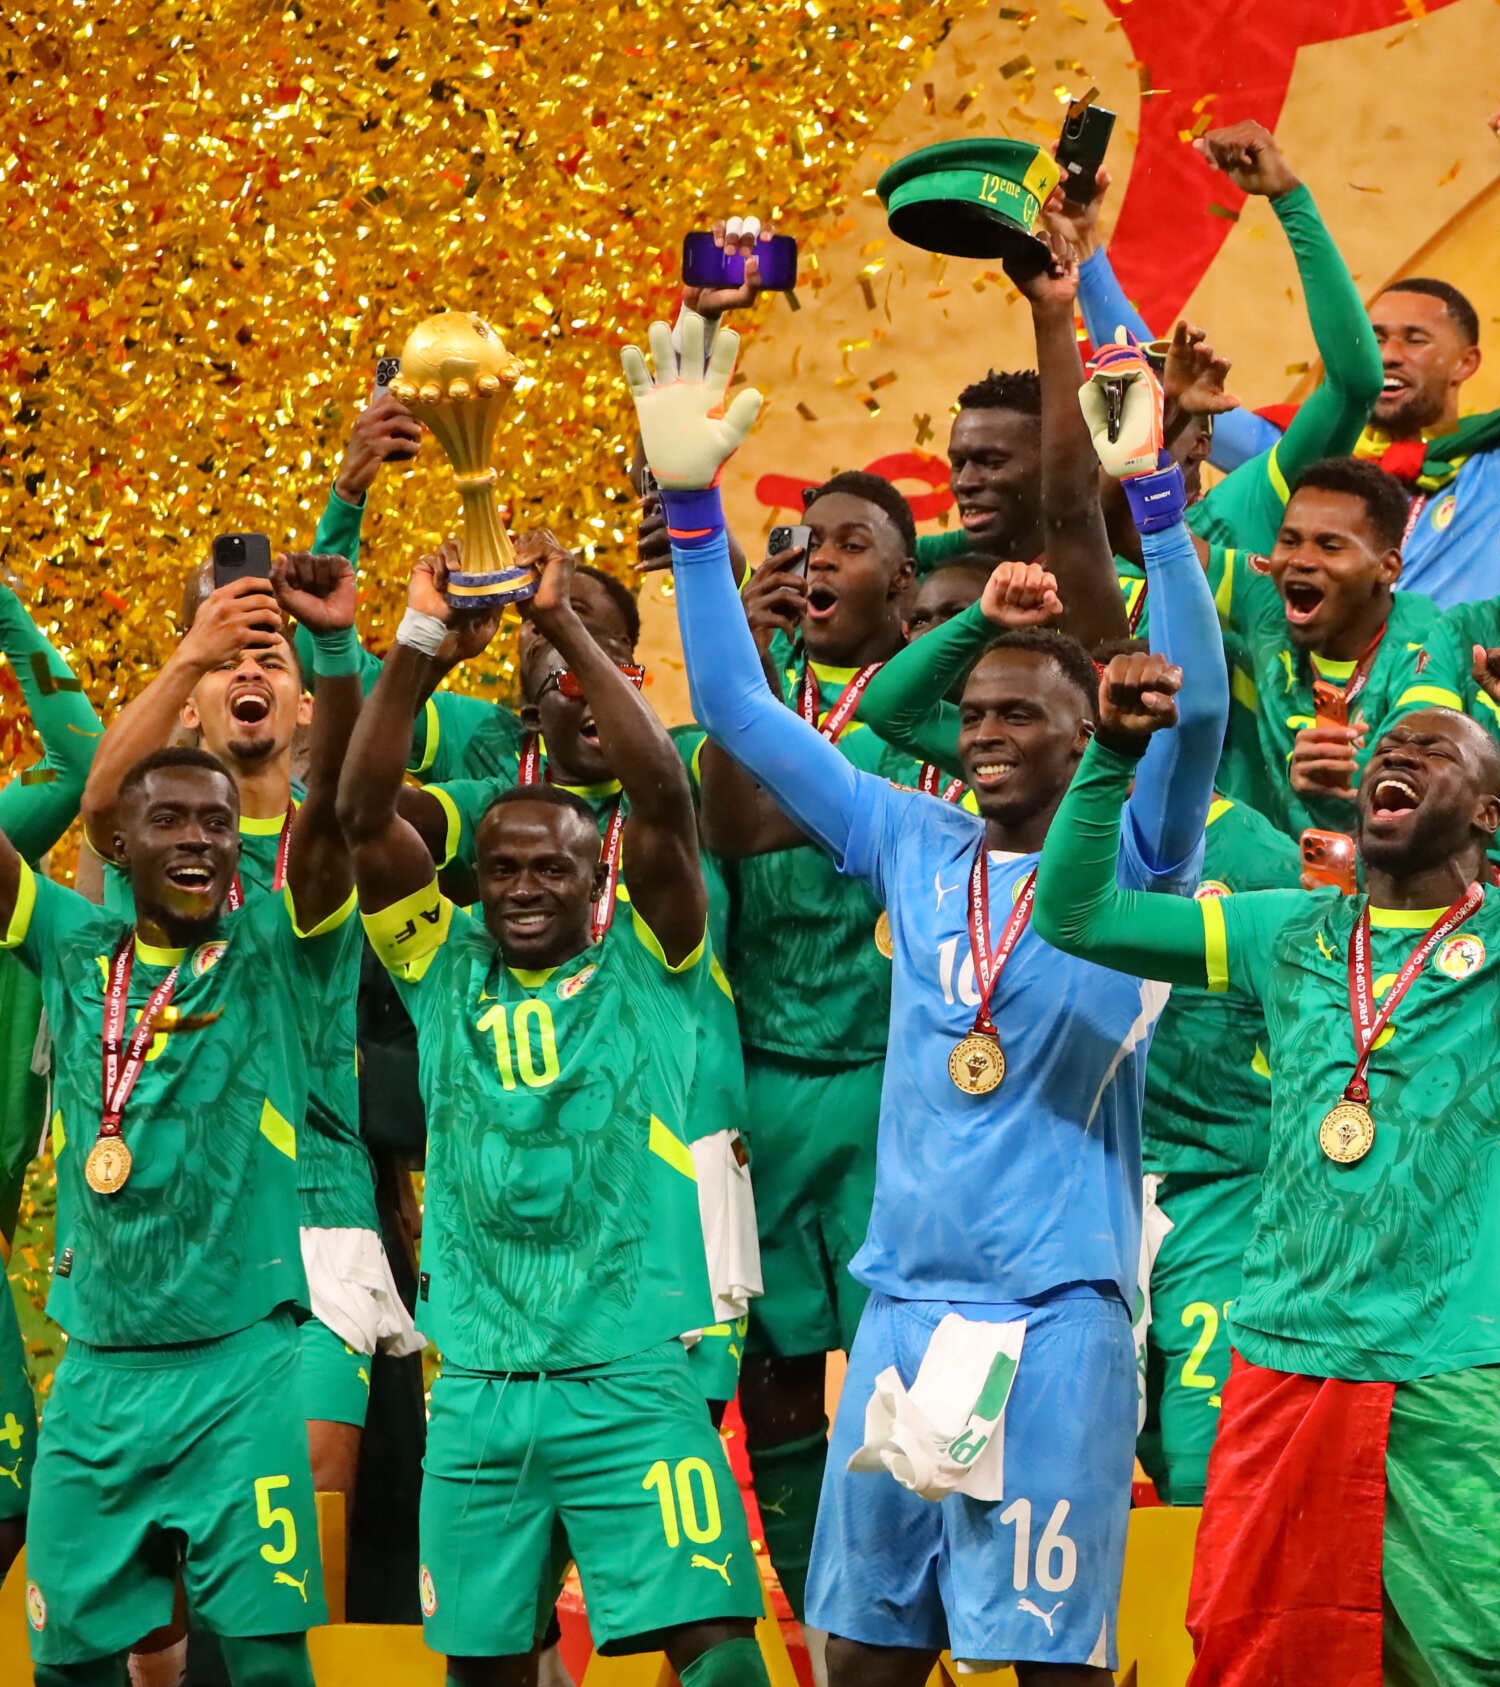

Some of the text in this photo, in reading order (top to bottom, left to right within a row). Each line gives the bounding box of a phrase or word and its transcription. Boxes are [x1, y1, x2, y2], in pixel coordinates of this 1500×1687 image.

[829, 703, 849, 729] AFRICA
[846, 686, 857, 702] CUP
[974, 909, 982, 925] CUP
[976, 925, 985, 956] AFRICA
[1003, 919, 1020, 951] AFRICA
[1016, 900, 1027, 918] CUP
[1356, 974, 1365, 992] CUP
[1381, 982, 1403, 1011] AFRICA
[1400, 964, 1414, 981] CUP
[1413, 952, 1424, 964] OF
[1422, 922, 1451, 953] NATIONS
[110, 998, 119, 1016] CUP
[112, 985, 120, 997] OF
[1358, 992, 1368, 1024] AFRICA
[106, 1017, 118, 1050] AFRICA
[132, 1025, 147, 1057] AFRICA
[153, 992, 163, 1005] OF
[476, 999, 560, 1092] 10
[1181, 1301, 1232, 1389] 2
[253, 1474, 299, 1564] 5
[643, 1456, 722, 1549] 10
[1000, 1497, 1078, 1593] 16
